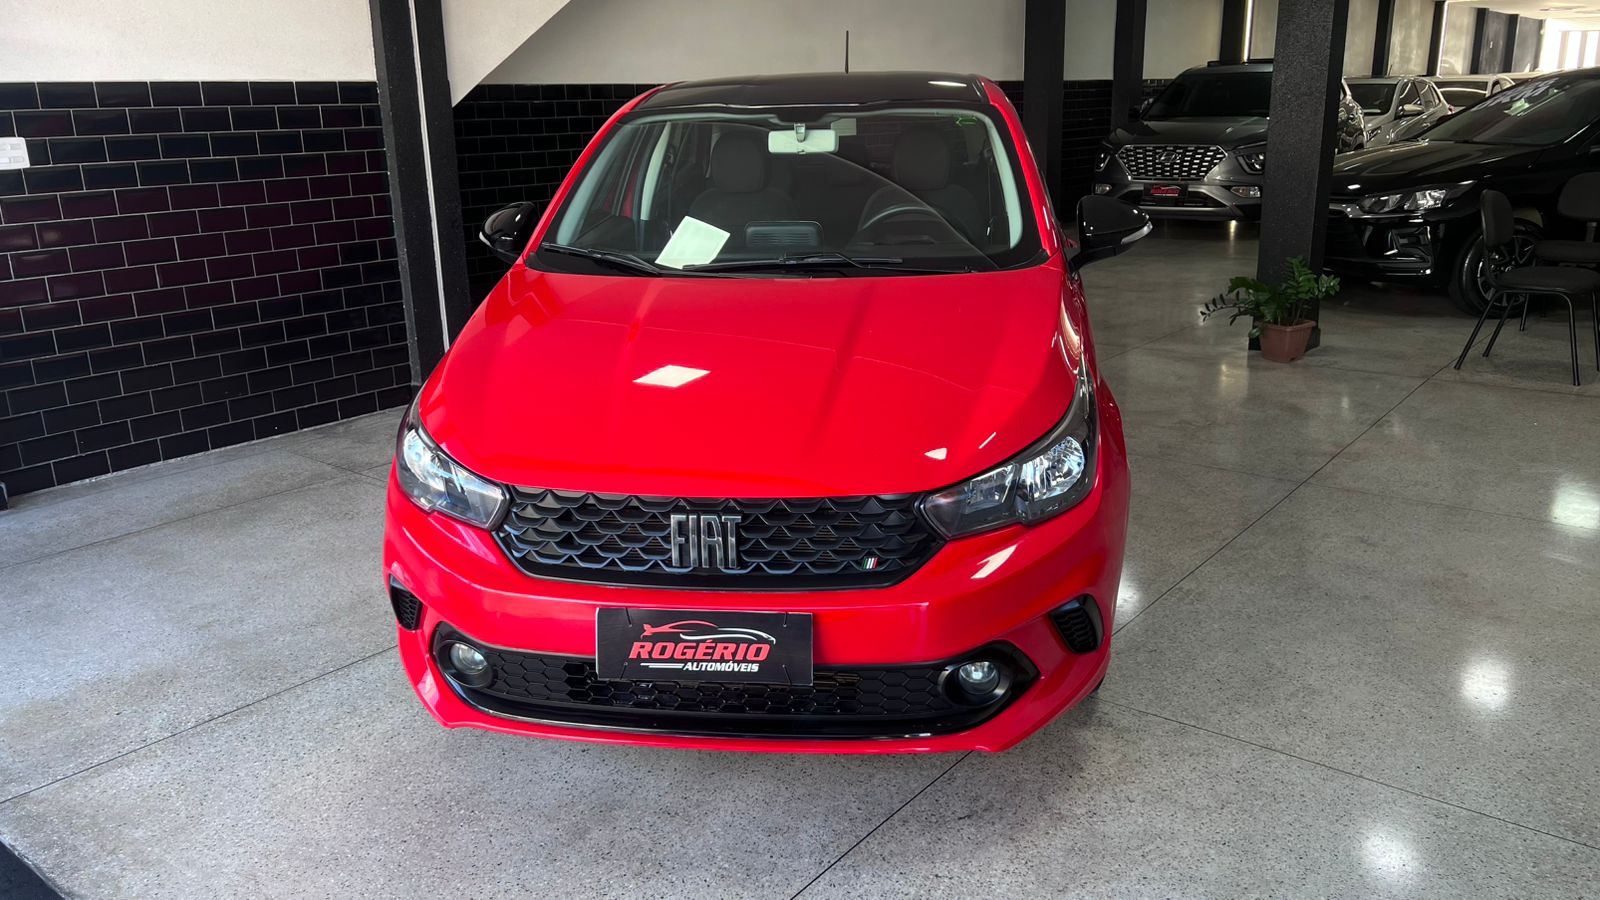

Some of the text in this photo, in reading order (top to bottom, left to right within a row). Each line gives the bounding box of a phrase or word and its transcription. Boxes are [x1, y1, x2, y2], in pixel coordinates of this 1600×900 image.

[670, 514, 742, 569] FIAT
[628, 639, 771, 661] ROGÉRIO
[683, 660, 760, 673] AUTOMÓVEIS
